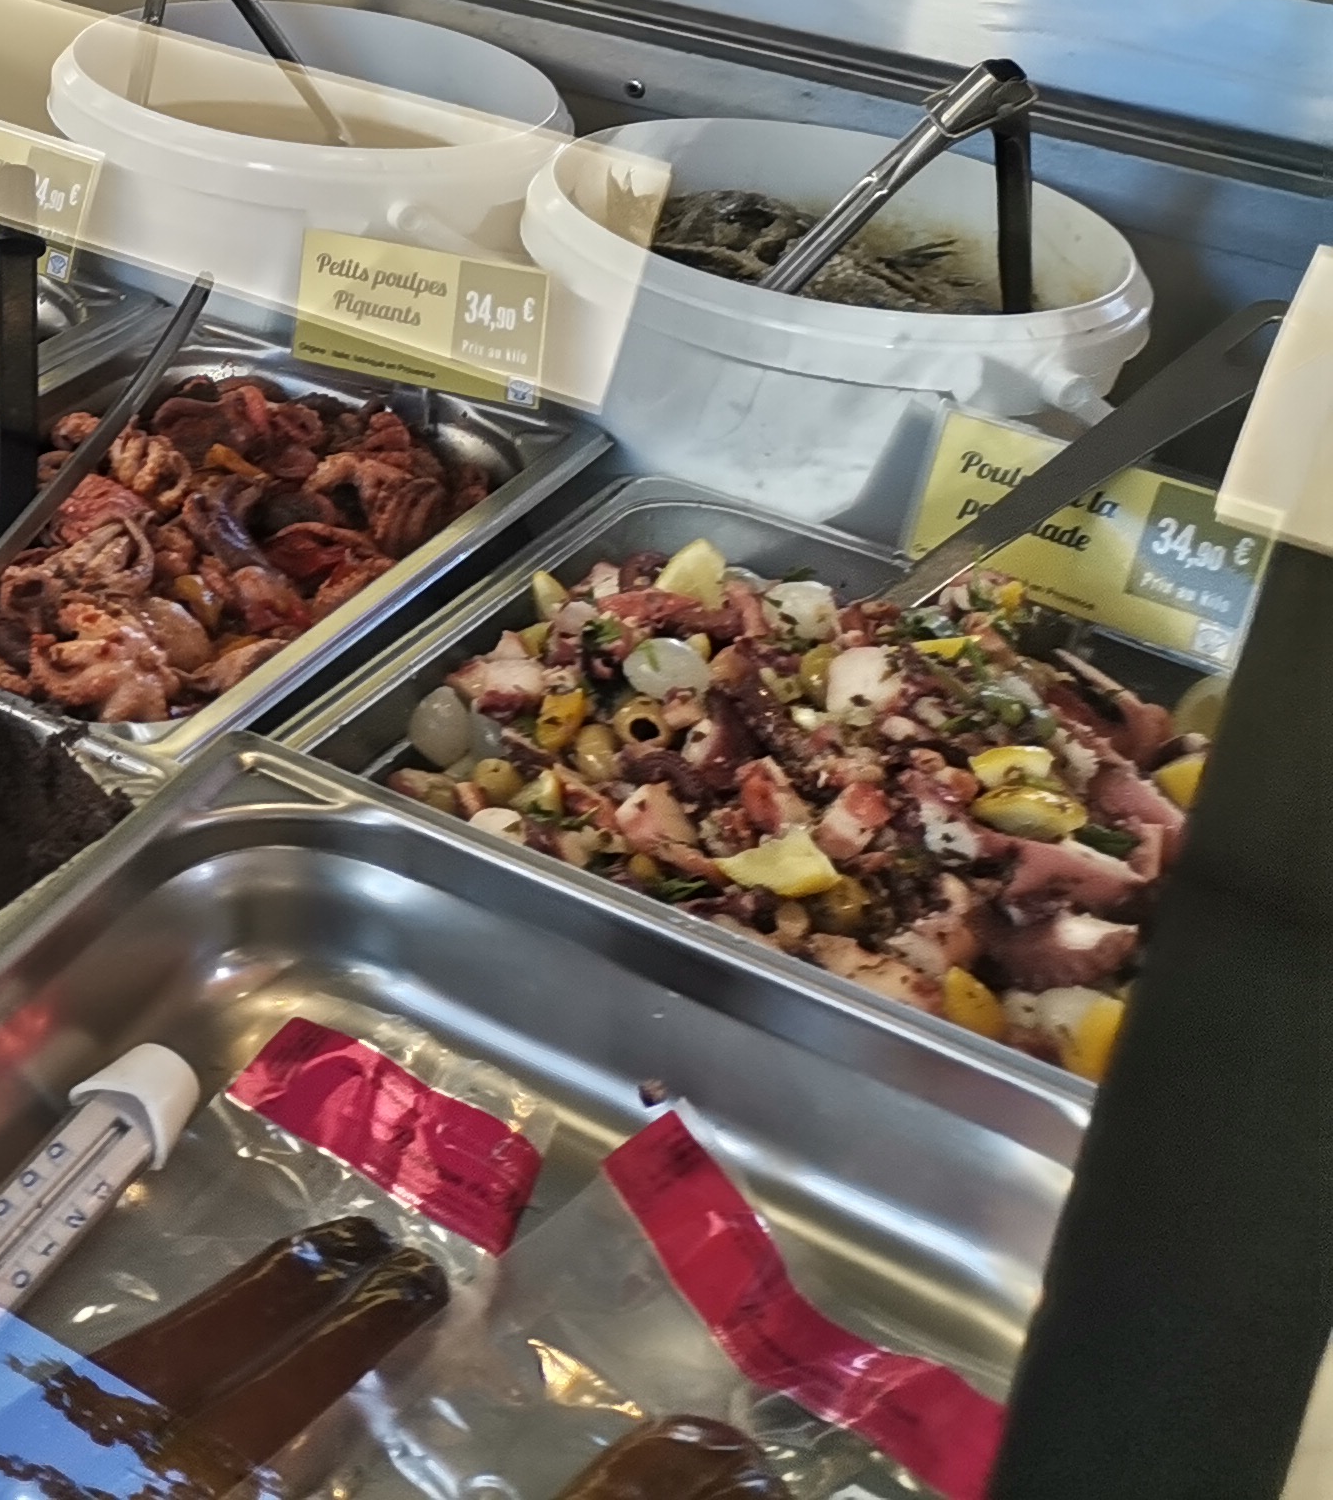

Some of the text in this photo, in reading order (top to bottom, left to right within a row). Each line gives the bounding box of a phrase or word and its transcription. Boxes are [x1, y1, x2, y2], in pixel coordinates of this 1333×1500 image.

[35, 173, 67, 213] 4,90
[68, 183, 82, 206] €
[315, 252, 449, 299] Petits poulpes
[332, 289, 536, 332] Piquants 34,90 €
[461, 339, 528, 365] Prix au kilo
[1085, 490, 1121, 519] la
[1151, 516, 1228, 573] 34,90
[1232, 536, 1257, 568] €
